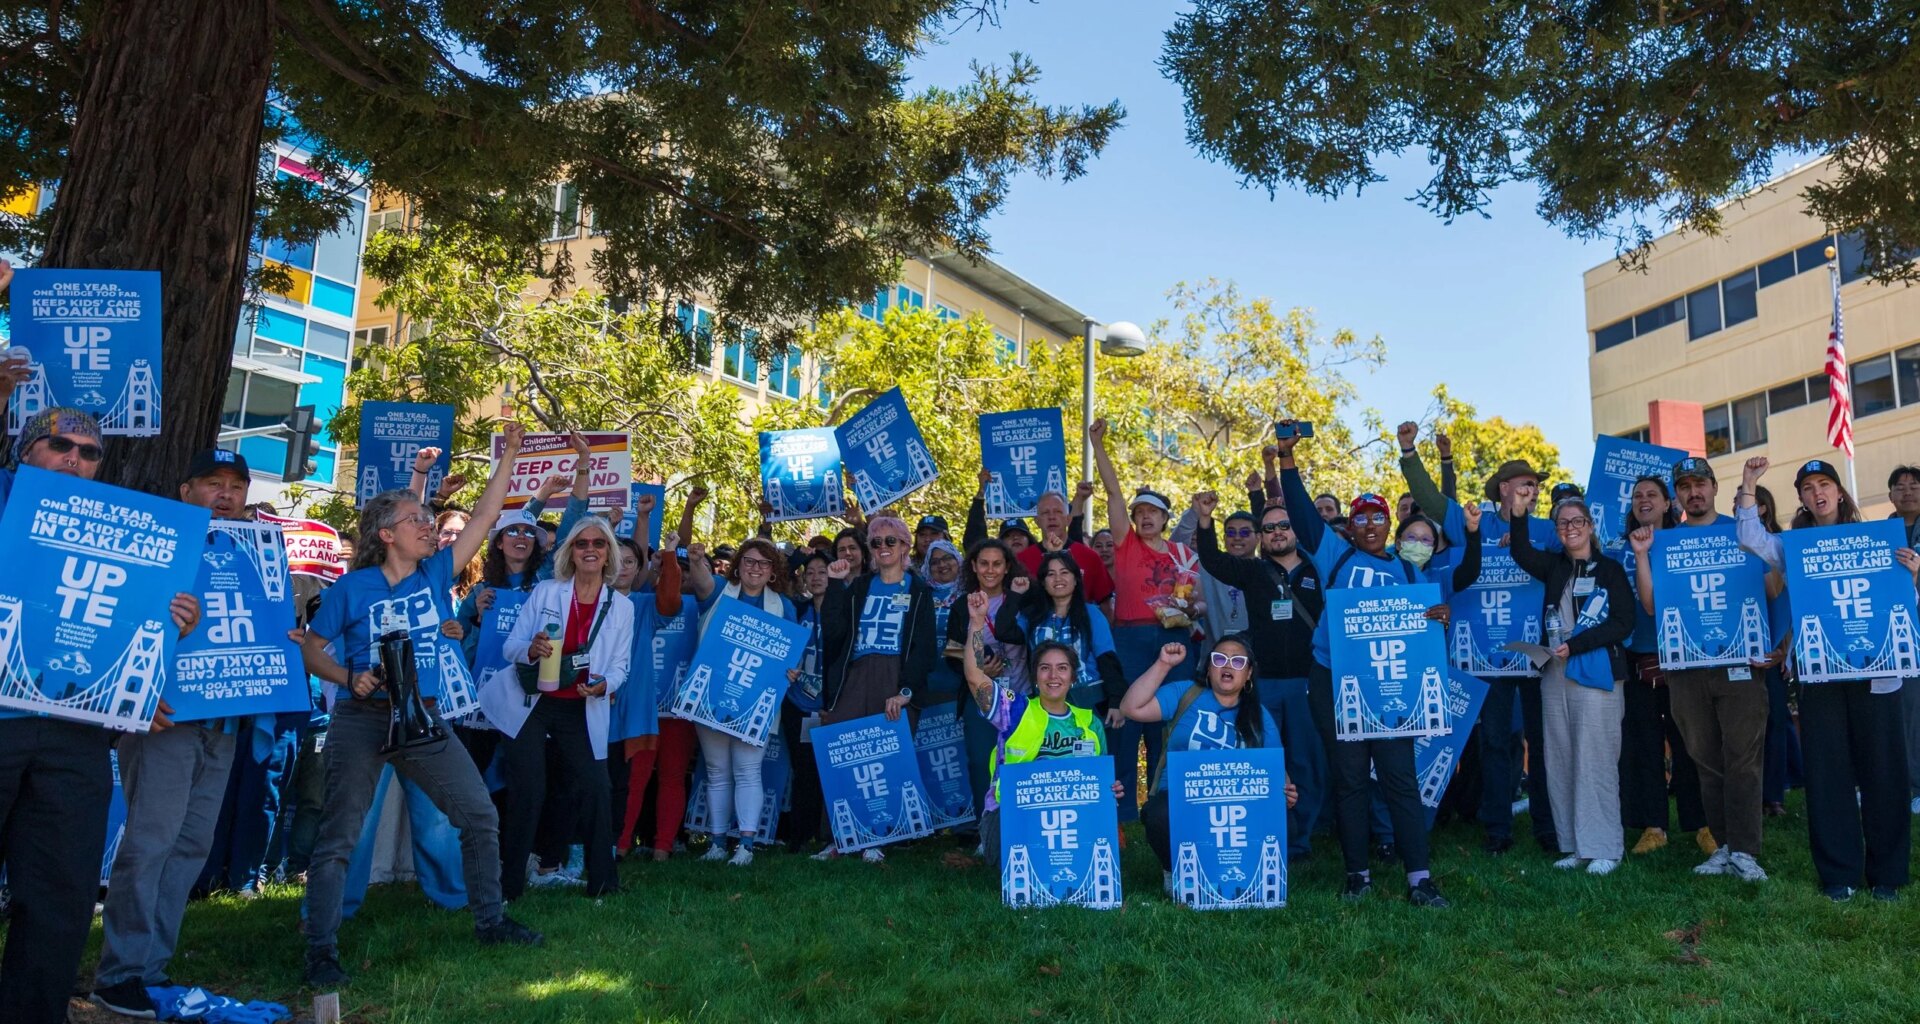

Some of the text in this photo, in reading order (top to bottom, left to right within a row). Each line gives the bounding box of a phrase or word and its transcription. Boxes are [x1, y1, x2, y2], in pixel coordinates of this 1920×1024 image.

[33, 307, 140, 317] IN OAKLAND
[64, 327, 111, 348] UP
[64, 348, 110, 370] TE
[388, 428, 439, 437] OAKLAND
[524, 436, 562, 446] Children's
[1005, 432, 1052, 441] OAKLAND
[391, 442, 420, 457] UP
[535, 442, 567, 451] Oakland
[865, 431, 888, 453] UP
[788, 455, 813, 468] UP
[870, 442, 896, 464] TE
[1010, 446, 1036, 461] UP
[788, 466, 814, 480] TE
[1011, 460, 1037, 475] TE
[1605, 464, 1616, 472] IN
[41, 499, 177, 536] ONE BRIDGE TOO FAR.
[69, 496, 156, 525] ONE YEAR.
[35, 510, 176, 550] KEEP KIDS' CARE
[32, 521, 173, 562] IN OAKLAND
[299, 539, 333, 550] CARE
[1817, 536, 1873, 547] ONE YEAR.
[289, 550, 339, 563] AKLAND
[1668, 554, 1746, 568] IN OAKLAND
[1803, 549, 1891, 563] KEEP KIDS' CARE
[1804, 557, 1892, 573] IN OAKLAND
[62, 556, 127, 594] UP
[1477, 574, 1530, 583] OAKLAND
[1690, 573, 1725, 593] UP
[1831, 578, 1870, 600] UP
[56, 586, 118, 627] TE
[204, 592, 252, 617] TE
[1482, 591, 1511, 608] UP
[1692, 592, 1727, 611] TE
[1482, 608, 1511, 625] TE
[1833, 598, 1873, 619] TE
[62, 621, 95, 633] University
[145, 620, 162, 632] SF
[497, 622, 510, 630] IN
[742, 615, 782, 636] ONE YEAR.
[1345, 616, 1369, 624] KEEP
[1346, 620, 1427, 633] IN OAKLAND
[56, 626, 97, 639] Professional
[63, 633, 94, 644] Technical
[208, 617, 255, 643] UP
[725, 621, 790, 651] KEEP KIDS' CARE
[55, 638, 91, 649] Employees
[440, 644, 450, 652] SF
[722, 627, 787, 658] IN OAKLAND
[1370, 640, 1406, 661] UP
[177, 654, 286, 670] IN OAKLAND
[731, 648, 762, 673] UP
[177, 666, 287, 681] KEEP KIDS' CARE
[728, 663, 756, 688] TE
[1371, 660, 1407, 680] TE
[201, 686, 272, 699] ONE YEAR.
[1450, 695, 1469, 708] CARE
[839, 727, 883, 740] ONE YEAR.
[829, 736, 898, 756] KEEP KIDS' CARE
[831, 742, 899, 763] IN OAKLAND
[929, 746, 958, 766] UP
[853, 763, 884, 783] UP
[932, 762, 962, 781] TE
[856, 779, 889, 799] TE
[1017, 790, 1099, 804] IN OAKLAND
[1186, 785, 1269, 797] IN OAKLAND
[1041, 810, 1077, 830] UP
[1210, 806, 1246, 827] UP
[1042, 829, 1078, 849] TE
[1210, 826, 1247, 847] TE
